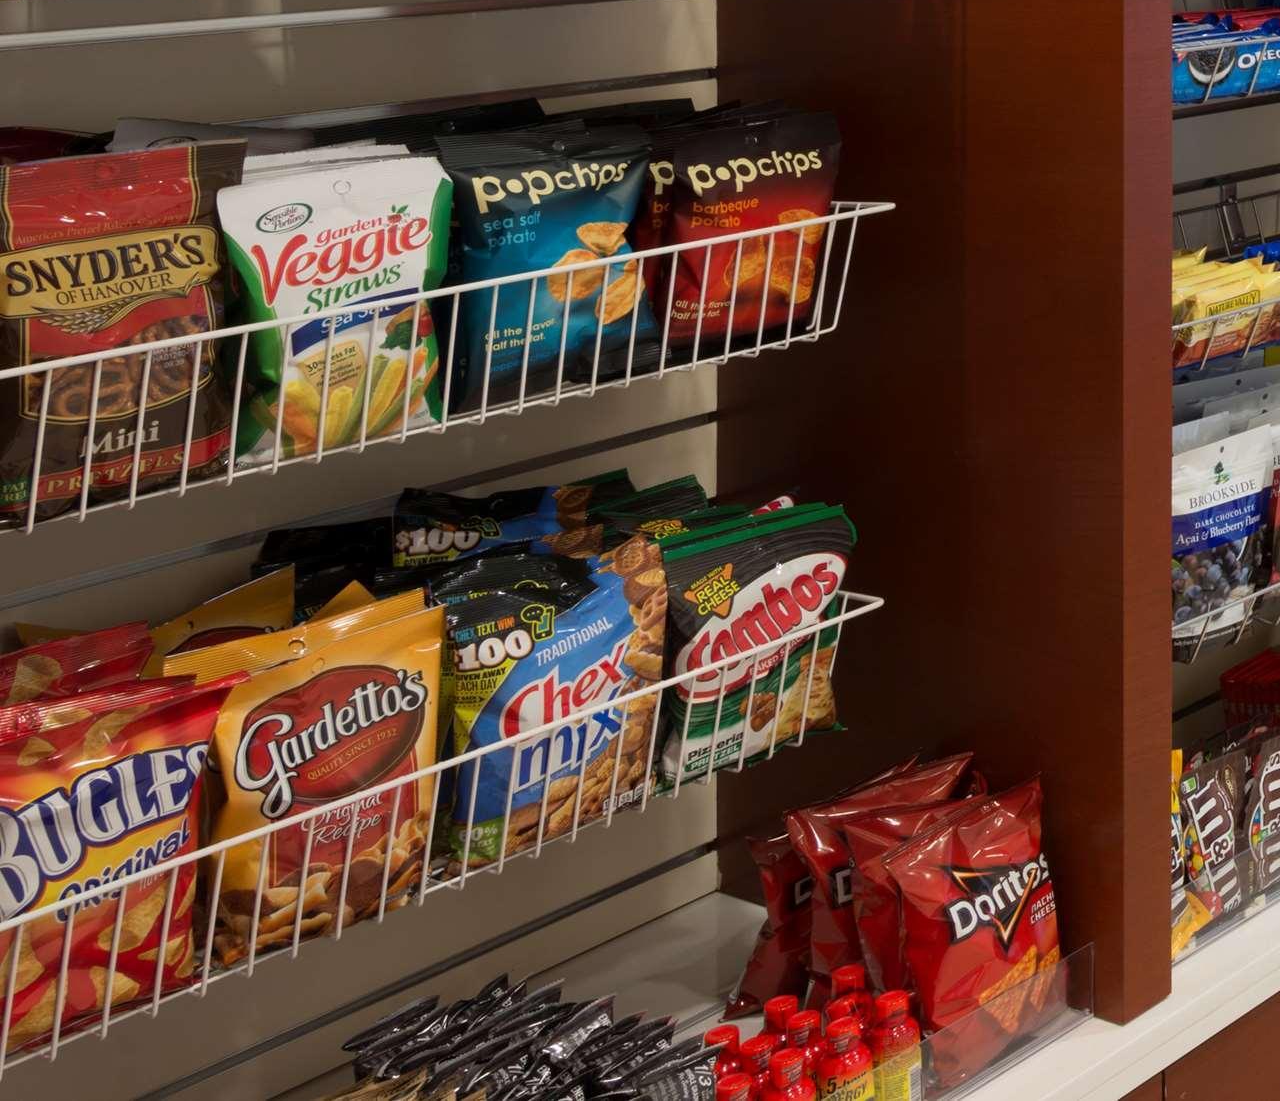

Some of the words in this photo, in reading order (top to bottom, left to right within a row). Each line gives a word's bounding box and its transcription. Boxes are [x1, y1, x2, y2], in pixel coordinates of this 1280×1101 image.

[471, 159, 627, 214] popchips
[686, 149, 823, 198] popchips
[263, 206, 299, 225] Sensible
[691, 215, 741, 228] potato
[692, 197, 759, 215] barbeque
[314, 216, 382, 249] garden
[483, 217, 514, 234] sea
[487, 229, 537, 250] potato
[5, 232, 206, 298] SNYDER'S
[250, 216, 432, 307] Veggie
[56, 290, 78, 306] OF
[82, 272, 174, 301] HANOVER
[303, 264, 401, 315] Straws
[1207, 299, 1234, 317] NATURE
[1233, 292, 1259, 308] VALLEY
[503, 325, 523, 337] the
[80, 420, 160, 459] Mini
[47, 450, 185, 494] PRETZELS
[1188, 478, 1257, 510] BROOKSIDE
[1194, 518, 1213, 531] DARK
[1214, 503, 1256, 523] CHOCOLATE
[1210, 517, 1245, 540] Blueberry
[697, 580, 741, 617] CHEESE
[698, 576, 732, 604] REAL
[686, 562, 838, 682] Combos
[535, 616, 614, 667] TRADITIONAL
[479, 677, 499, 690] DAY
[481, 666, 507, 679] AWAY
[502, 640, 627, 741] Chex
[235, 668, 428, 817] Gardetto's
[306, 757, 345, 782] QUALITY
[345, 742, 376, 766] SINCE
[315, 811, 385, 847] Recipe
[949, 856, 1050, 942] Doritos
